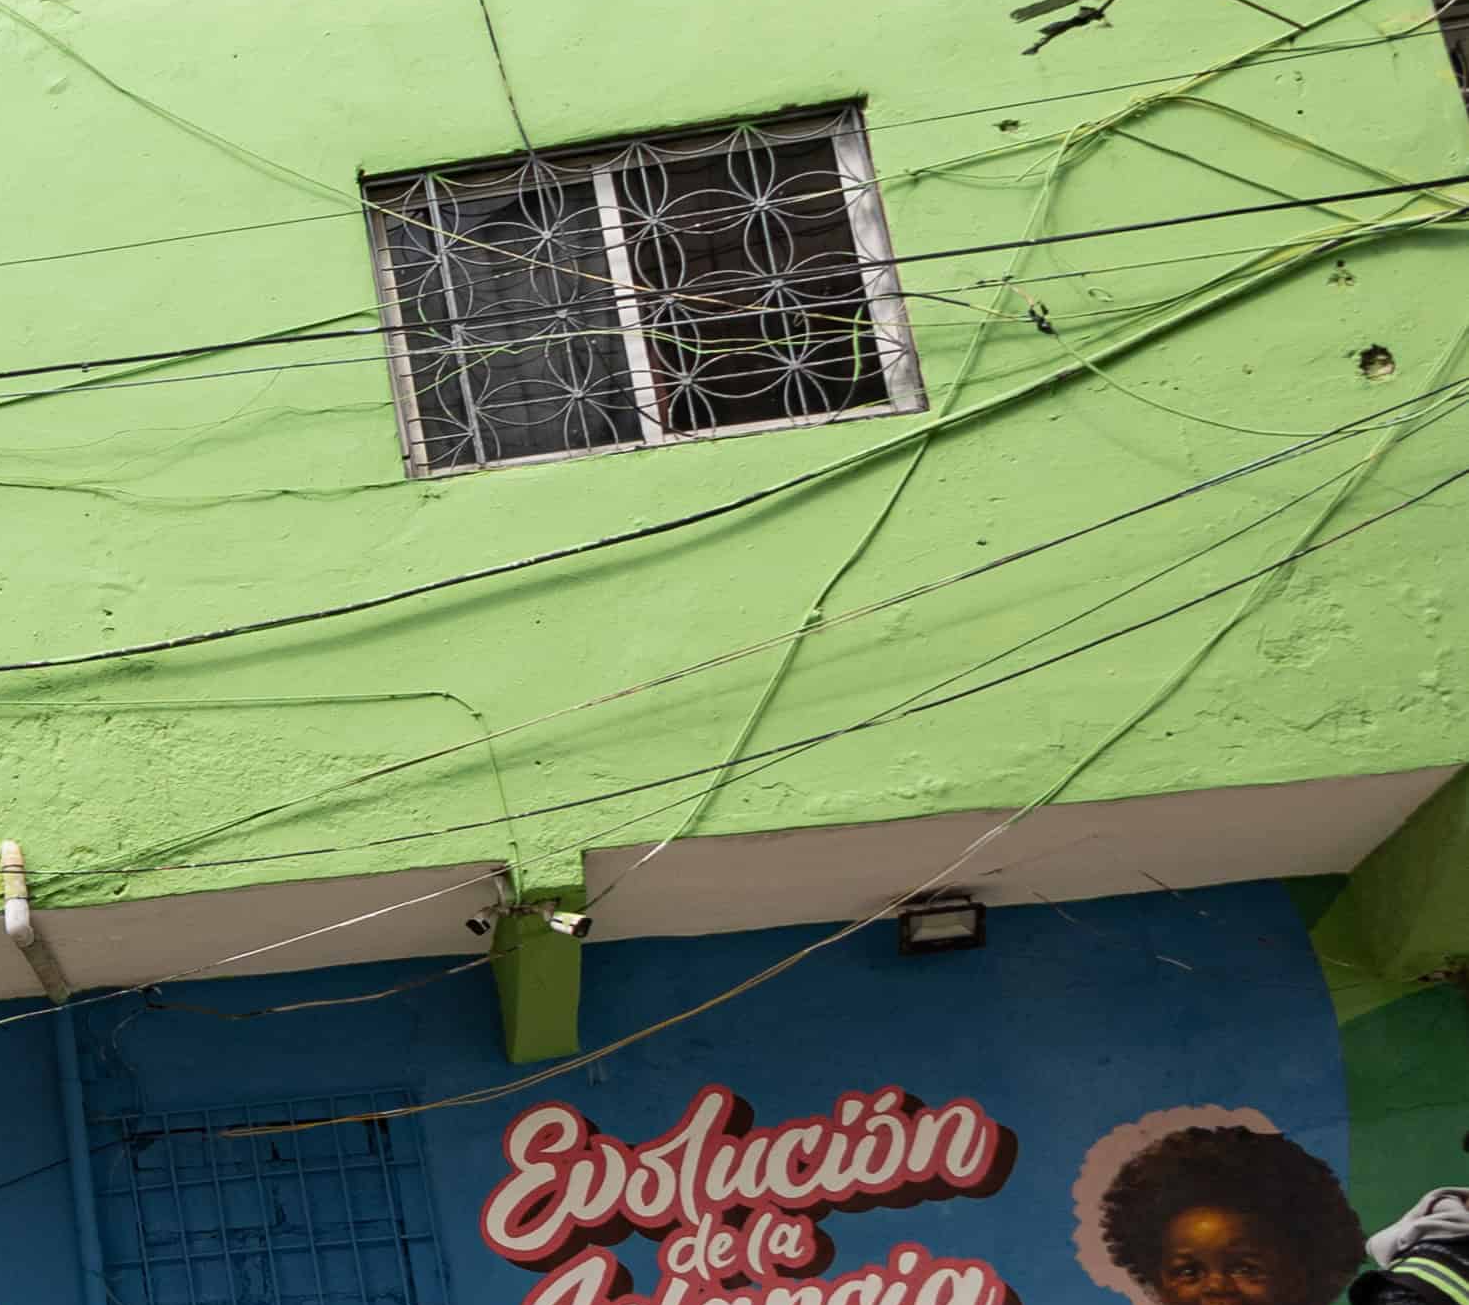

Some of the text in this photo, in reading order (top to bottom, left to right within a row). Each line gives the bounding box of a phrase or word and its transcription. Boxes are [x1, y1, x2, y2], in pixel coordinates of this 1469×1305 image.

[483, 1090, 989, 1253] Evolución
[665, 1211, 805, 1281] de la
